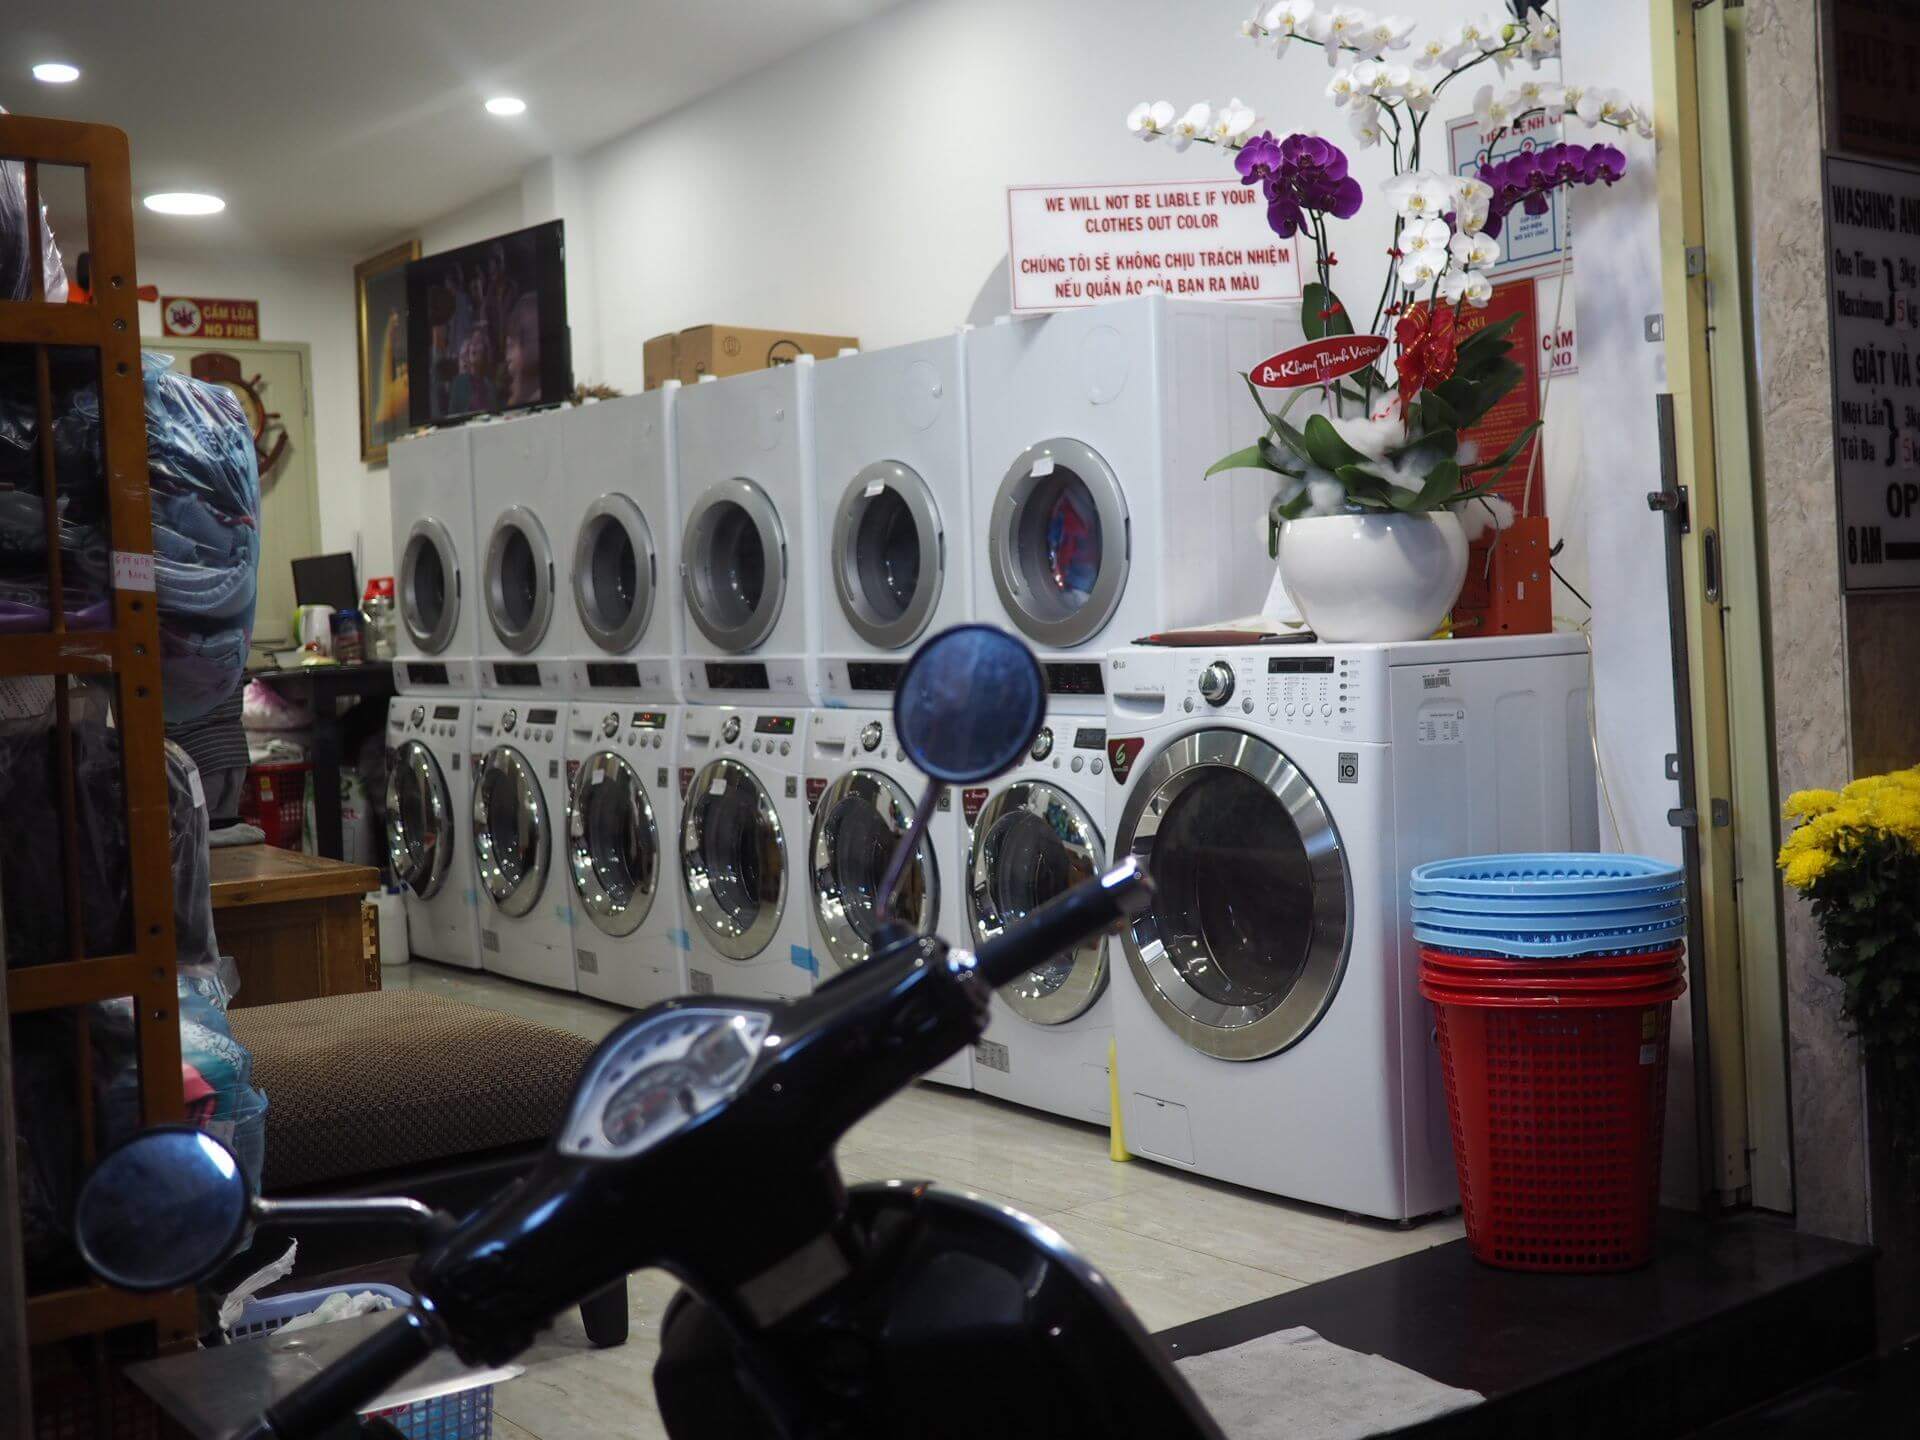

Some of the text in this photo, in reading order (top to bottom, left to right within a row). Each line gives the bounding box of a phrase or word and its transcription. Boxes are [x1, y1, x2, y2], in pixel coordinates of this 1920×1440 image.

[1046, 190, 1256, 212] WE WILL NOT BE LIABLE IF YOUR
[1832, 186, 1895, 231] WASHING
[1086, 213, 1219, 233] CLOTHES OUT COLOR
[1021, 245, 1290, 273] CHÚNG TÔI SẼ KHÔNG CHỊU TRÁCH NHIỆM
[1836, 249, 1852, 276] One
[1855, 251, 1876, 279] Time
[1055, 277, 1081, 298] NẾU
[1086, 275, 1121, 299] QUẦN
[1126, 277, 1143, 295] ÁO
[1178, 278, 1205, 296] BẠN
[1210, 277, 1227, 292] RA
[1231, 272, 1260, 291] MÀU
[204, 324, 256, 339] NO FIRE
[1551, 351, 1572, 367] NO
[1853, 343, 1886, 394] GIẶT
[1891, 342, 1912, 387] VÀ
[1263, 366, 1280, 383] An
[1841, 401, 1861, 429] Một
[1887, 483, 1920, 518] OP
[1848, 526, 1882, 564] 8 AM
